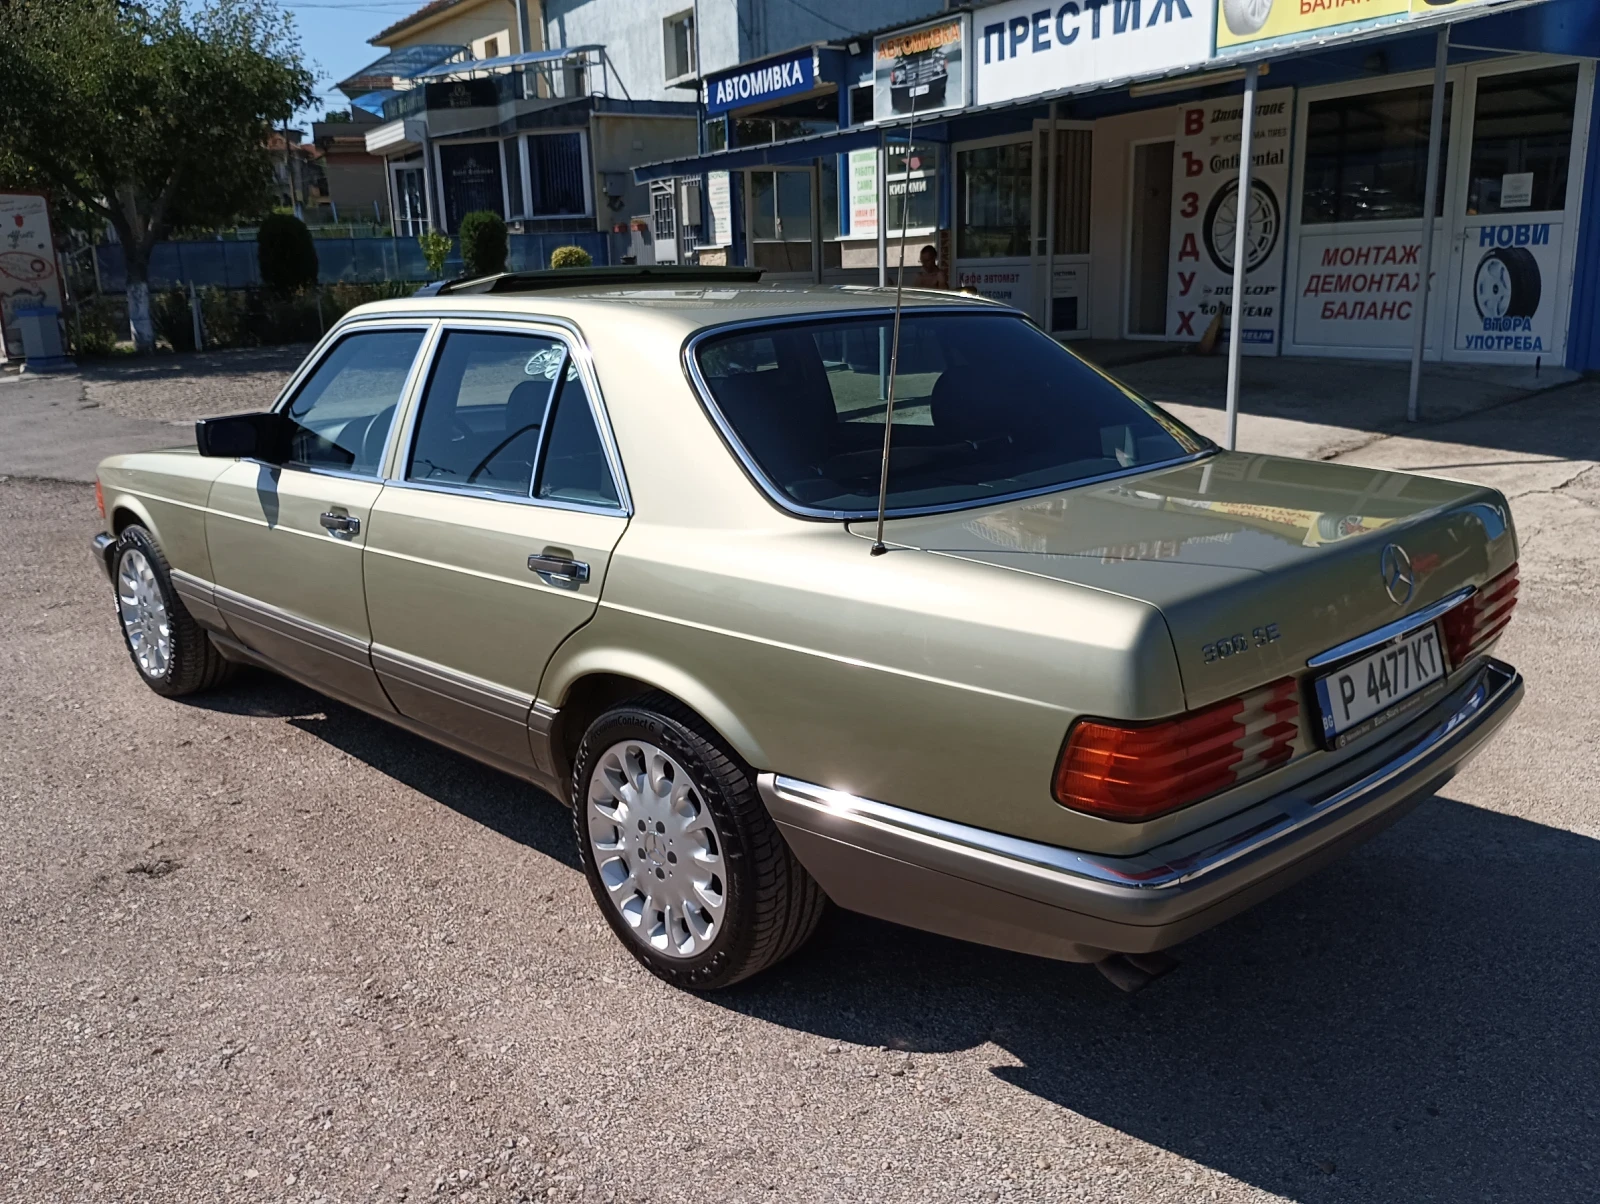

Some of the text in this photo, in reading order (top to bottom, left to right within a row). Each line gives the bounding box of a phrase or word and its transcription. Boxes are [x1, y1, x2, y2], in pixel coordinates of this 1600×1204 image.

[877, 23, 961, 60] АВТОМИВКА
[983, 0, 1193, 65] ПРЕСТИЖ
[716, 60, 804, 104] АВТОМИВКА
[1175, 108, 1205, 336] ВЪЗДУХ
[1479, 223, 1550, 247] НОВИ
[1320, 244, 1422, 267] МОНТАЖ
[959, 271, 1020, 284] Кафе автомат
[1214, 286, 1277, 296] DULOP
[1320, 300, 1413, 321] БАЛАНС
[1483, 316, 1532, 332] ВТОРА
[1465, 334, 1543, 351] УПОТРЕБА
[1202, 623, 1282, 665] 300 SE
[1339, 674, 1355, 721] P
[648, 721, 656, 732] 6
[1323, 714, 1334, 730] BG
